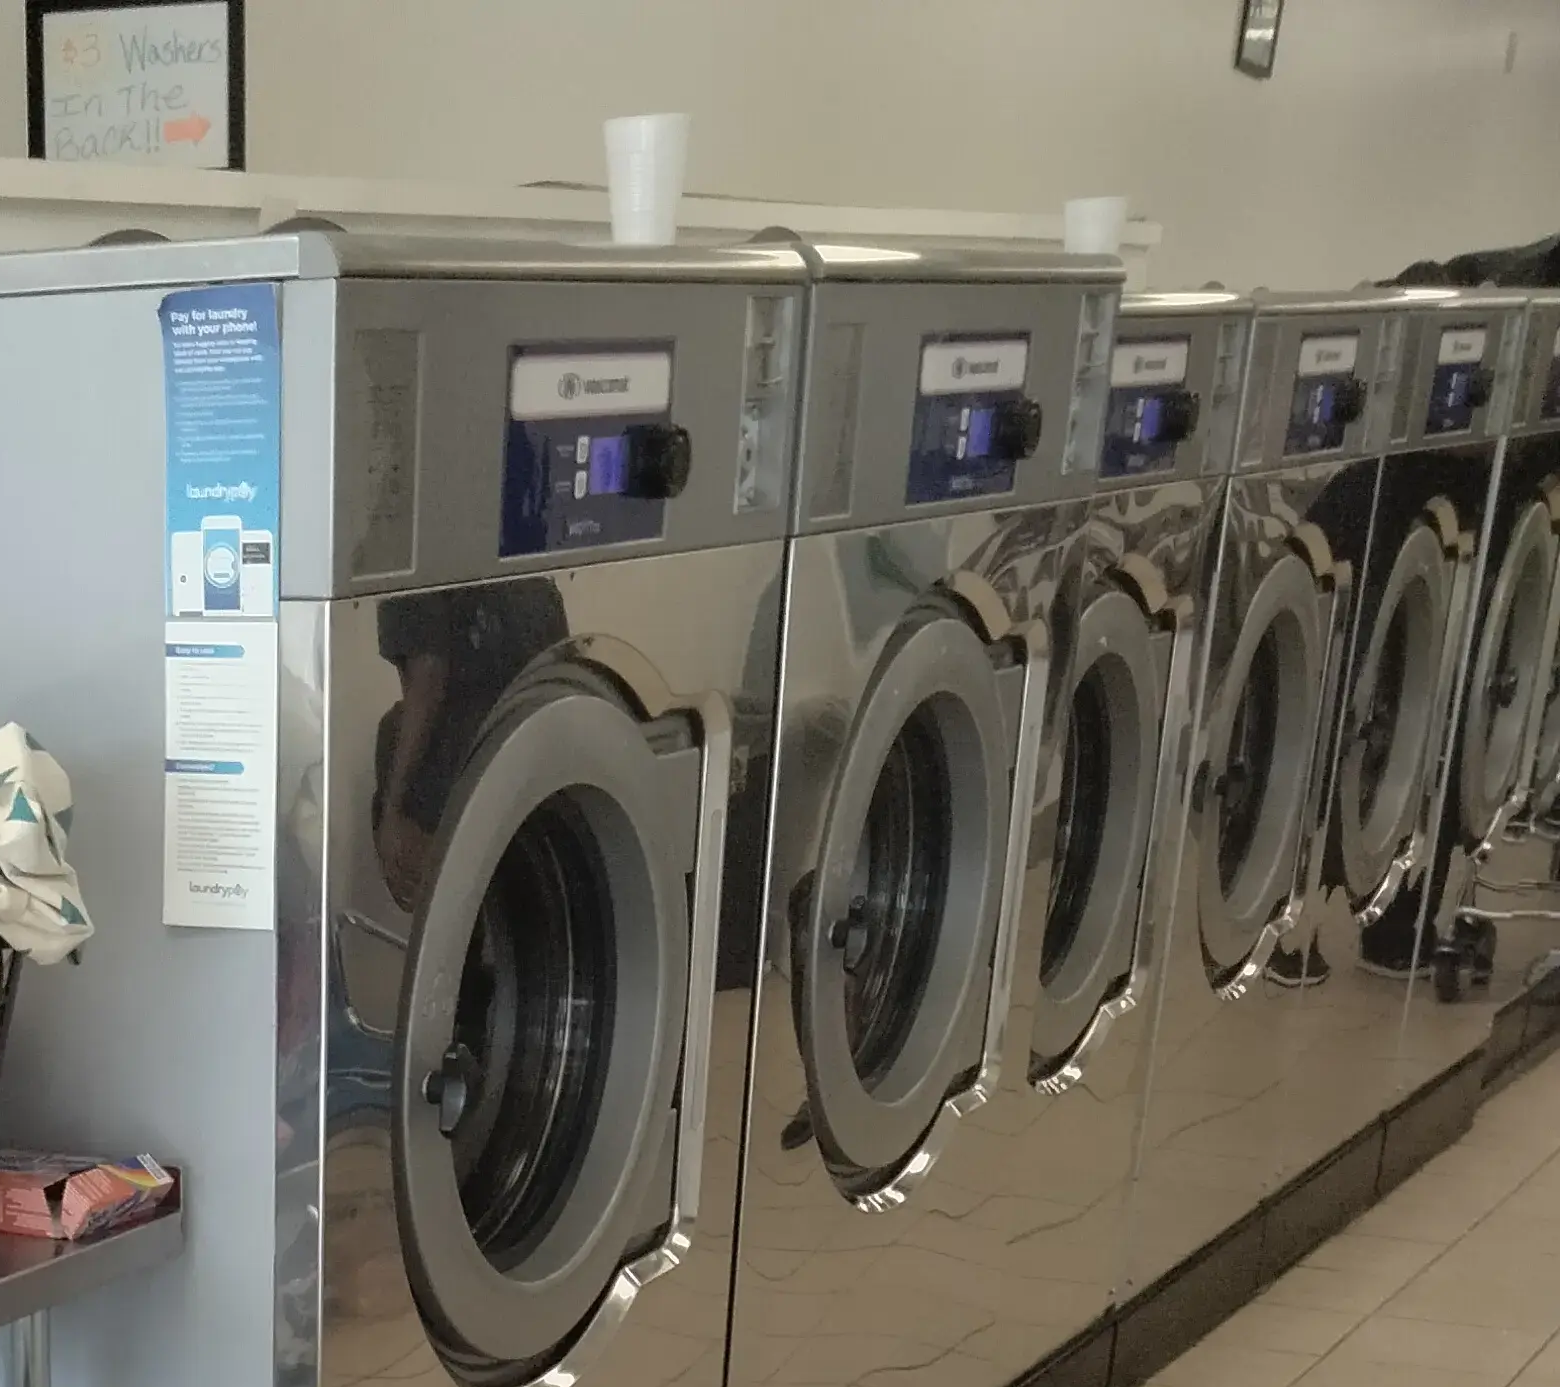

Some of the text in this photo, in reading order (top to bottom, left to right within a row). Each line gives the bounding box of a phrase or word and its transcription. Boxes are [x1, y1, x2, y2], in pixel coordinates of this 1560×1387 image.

[61, 25, 222, 73] $3 Washers
[51, 81, 189, 118] In The
[170, 307, 248, 323] Pay for laundry
[172, 321, 258, 337] with your phone!
